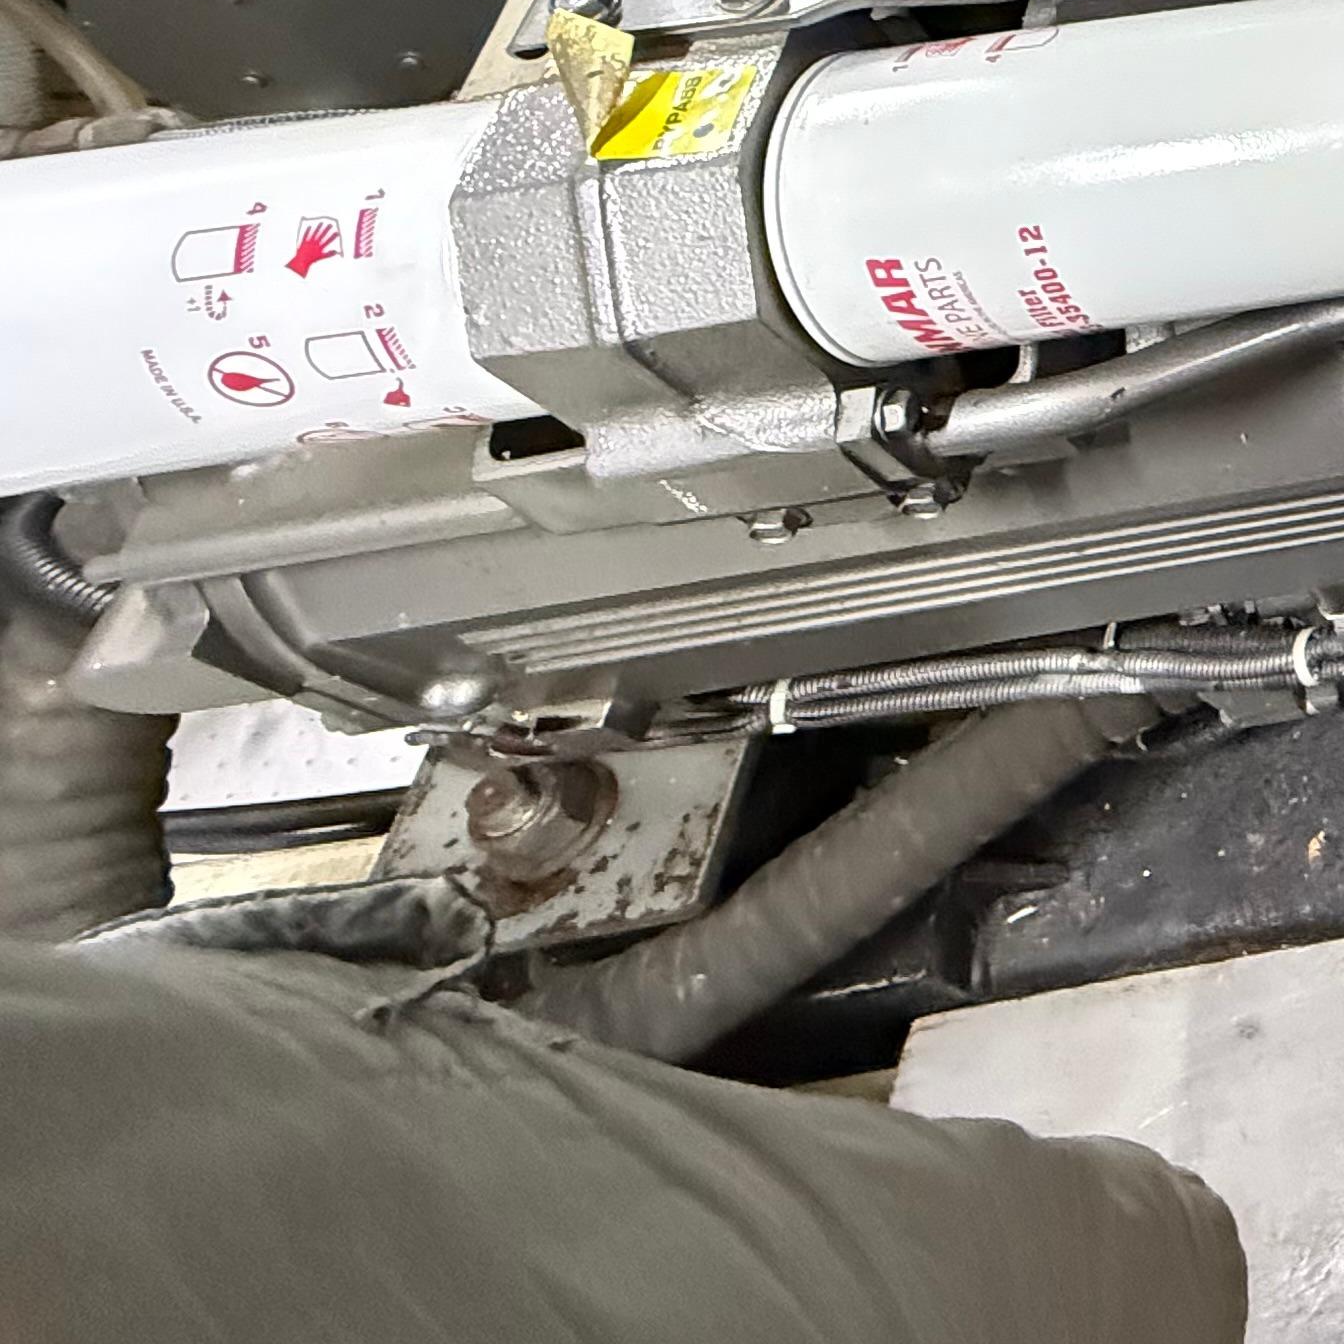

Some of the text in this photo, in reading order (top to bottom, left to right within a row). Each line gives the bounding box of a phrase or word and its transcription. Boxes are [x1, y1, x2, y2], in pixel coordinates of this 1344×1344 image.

[246, 201, 267, 216] 4
[914, 257, 968, 322] PARTS
[1018, 225, 1104, 332] -35400-12
[363, 303, 385, 319] 2
[866, 258, 968, 353] NMAR
[1018, 289, 1065, 330] Filter
[249, 334, 270, 350] 5
[140, 349, 169, 384] MADE
[160, 385, 178, 397] IN
